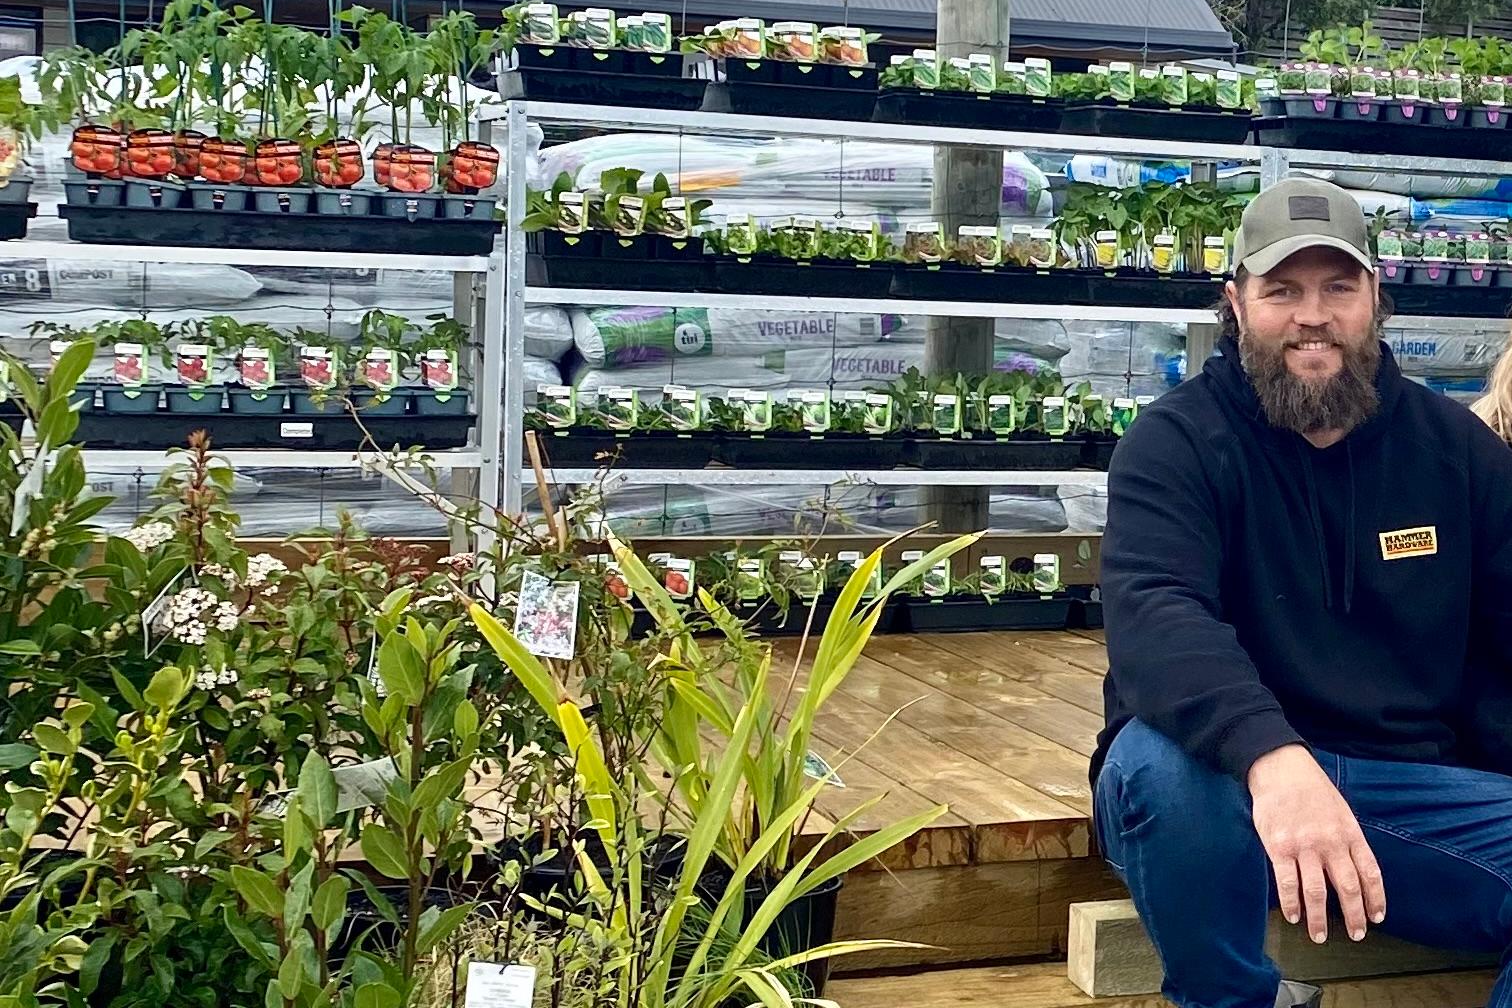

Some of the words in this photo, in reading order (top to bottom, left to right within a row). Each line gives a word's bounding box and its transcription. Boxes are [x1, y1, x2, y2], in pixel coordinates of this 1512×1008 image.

[823, 167, 896, 182] TABLE
[758, 319, 834, 336] VEGETABLE
[1392, 342, 1436, 356] GARDEN
[833, 358, 906, 374] VEGETABLE
[1384, 531, 1433, 544] HAMMER
[1386, 540, 1434, 551] HARDWARE
